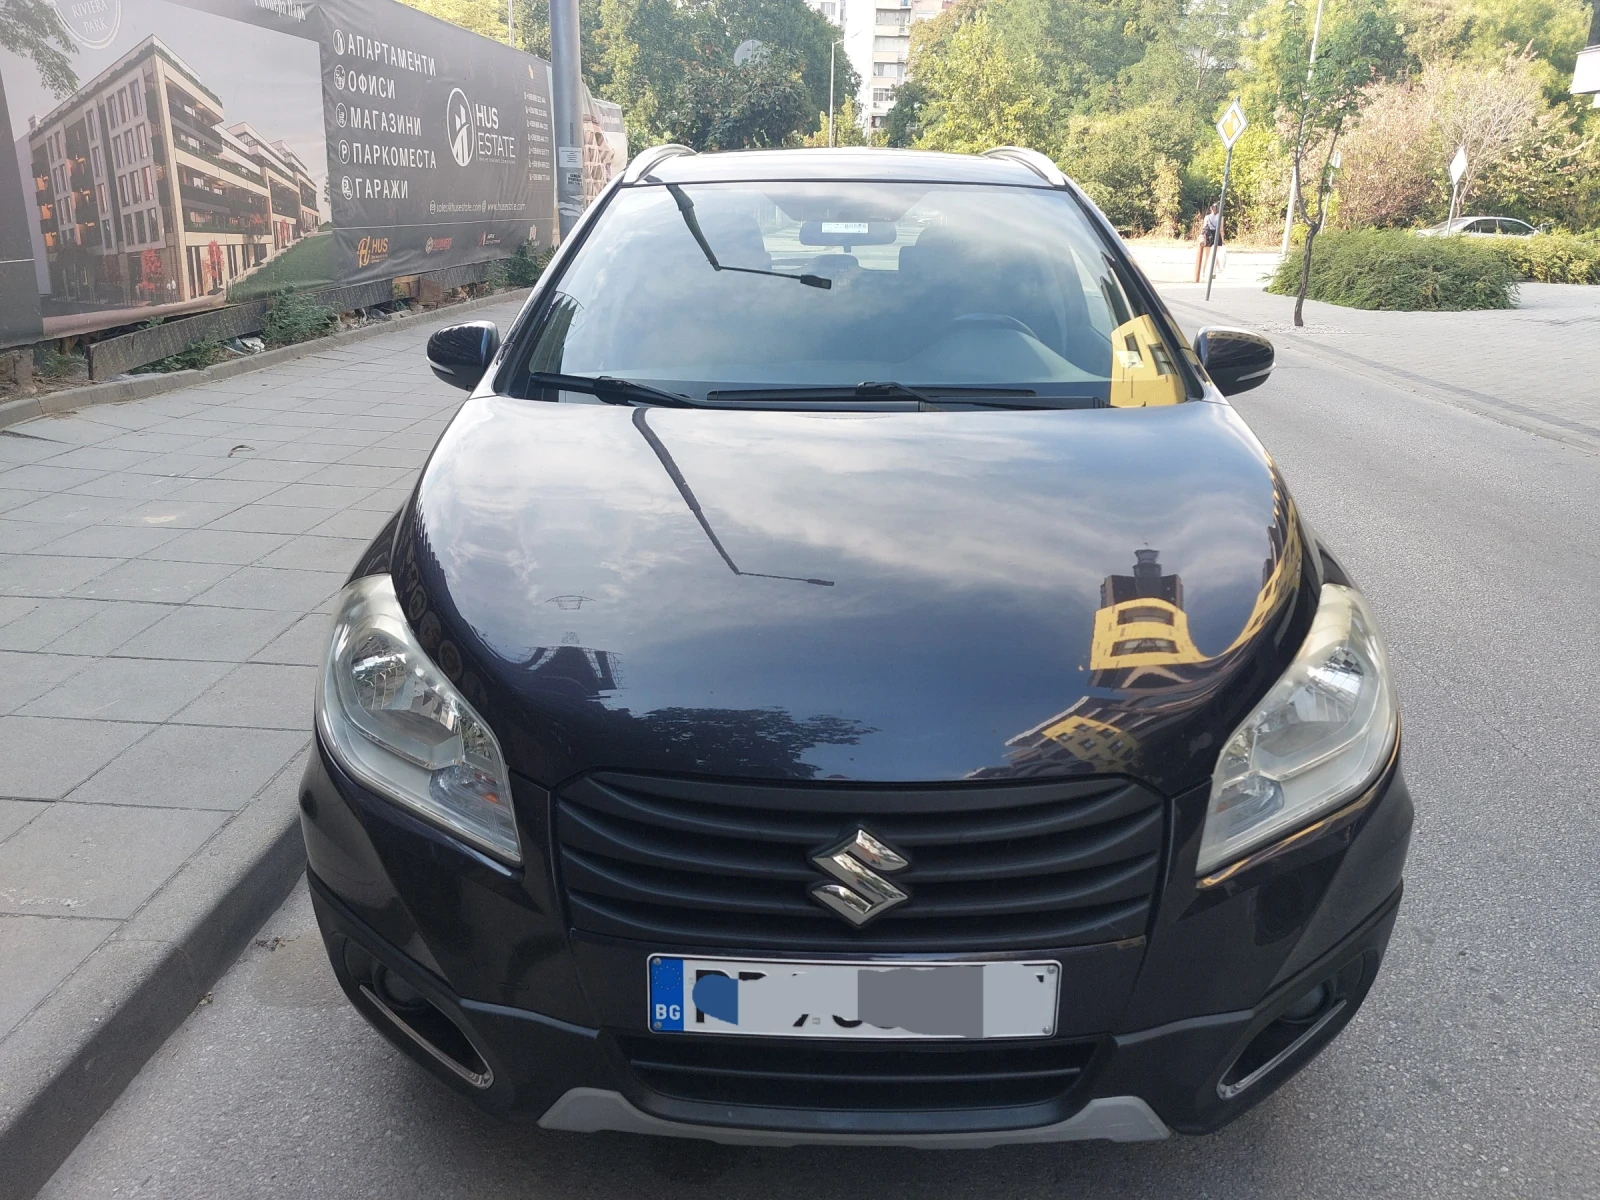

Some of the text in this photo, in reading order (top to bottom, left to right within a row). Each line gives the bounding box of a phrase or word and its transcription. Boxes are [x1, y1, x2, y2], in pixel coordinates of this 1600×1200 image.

[71, 0, 109, 18] RIVIERA
[83, 17, 108, 35] PARK
[347, 33, 436, 77] АПАРТАМЕНТИ
[348, 70, 396, 100] ОФИСИ
[350, 106, 422, 136] МАГАЗИНИ
[475, 103, 499, 130] HUS
[352, 142, 437, 169] ПАРКОМЕСТА
[477, 132, 516, 158] ESTATE
[355, 178, 408, 199] ГАРАЖИ
[371, 237, 389, 254] HUS
[655, 1003, 681, 1021] BG
